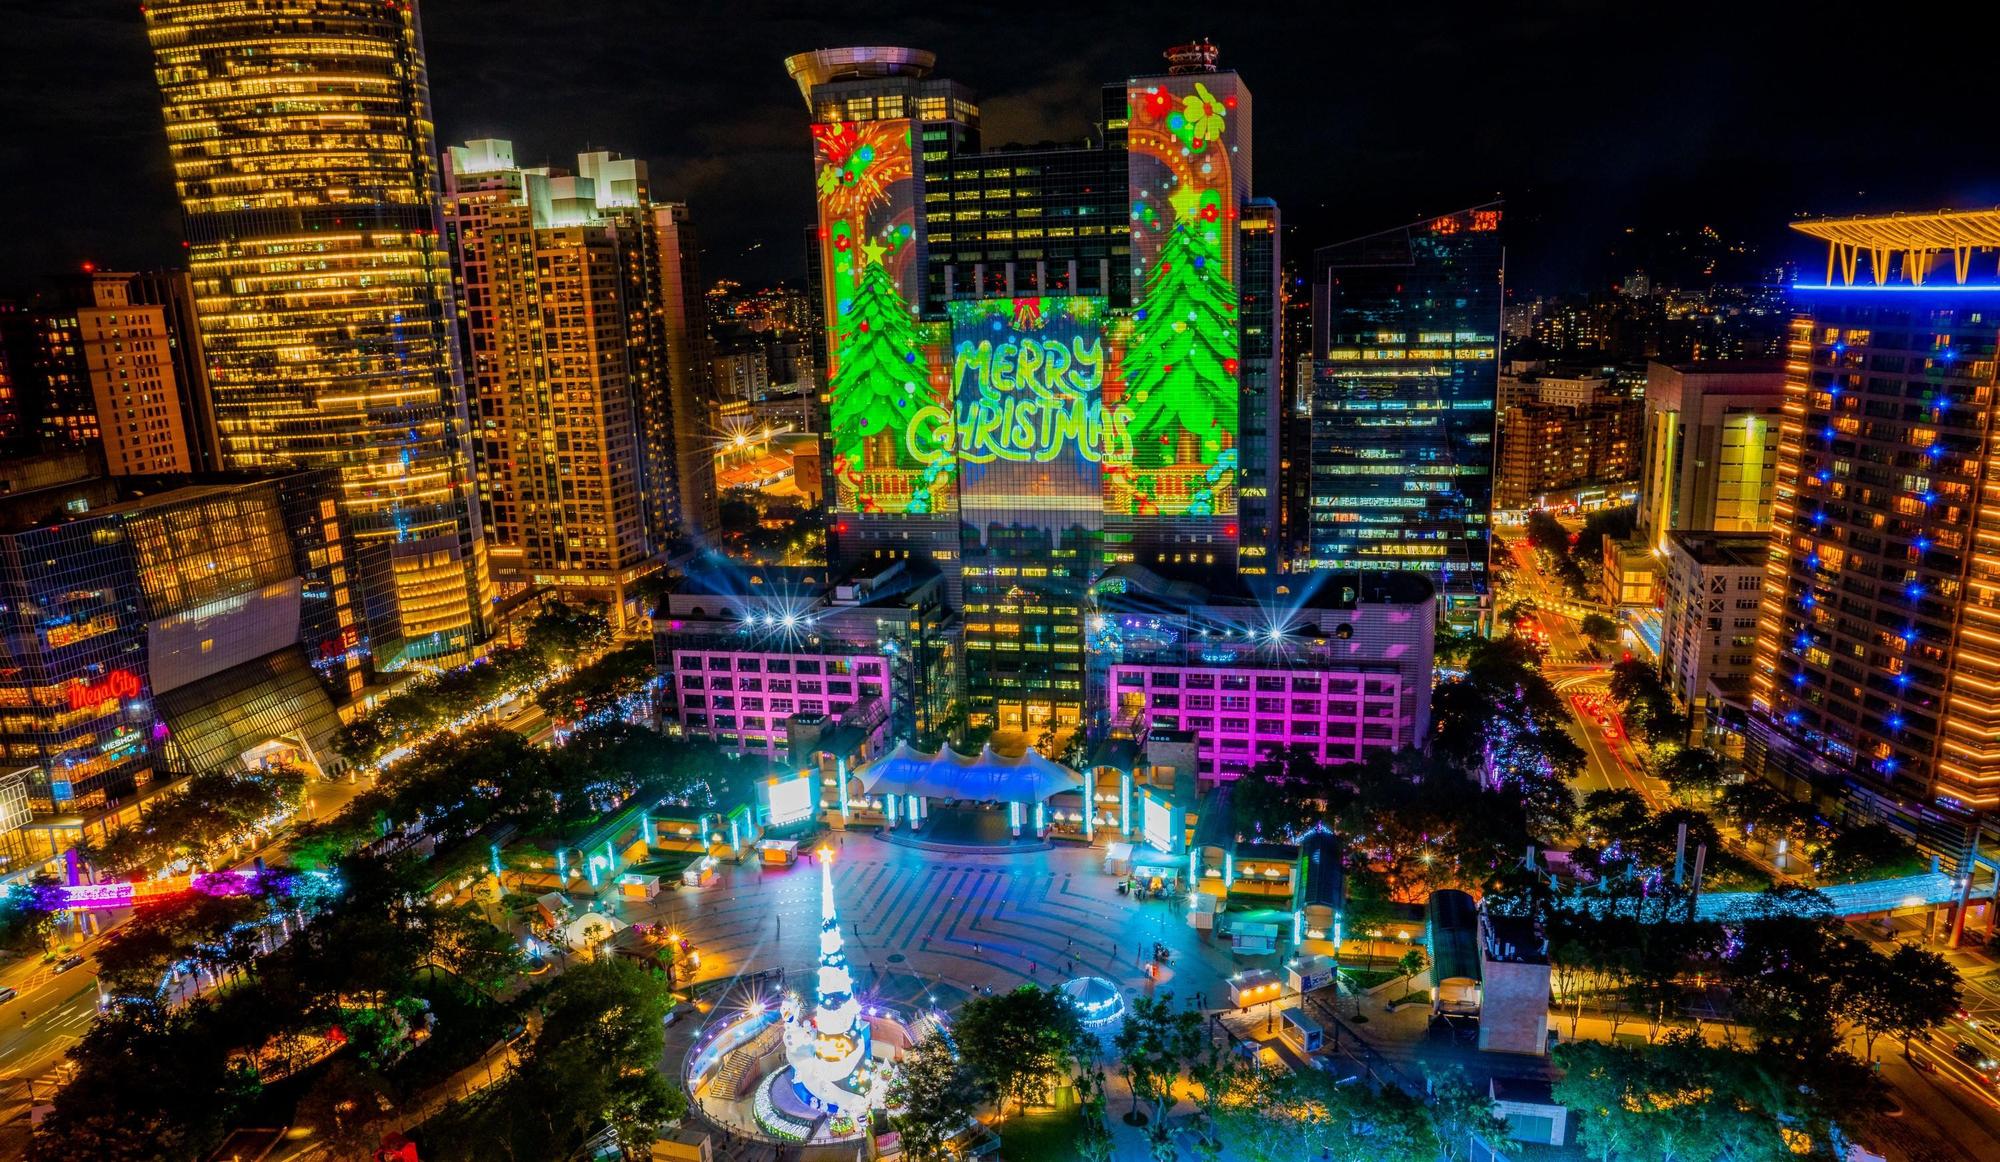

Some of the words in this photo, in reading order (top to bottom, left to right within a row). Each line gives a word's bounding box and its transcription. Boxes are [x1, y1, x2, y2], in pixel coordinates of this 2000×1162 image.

[948, 336, 1103, 400] MERRY
[907, 396, 1136, 463] CHRISTMAS
[69, 683, 110, 709] Mega
[110, 671, 138, 697] City
[101, 731, 140, 751] VIESHOW
